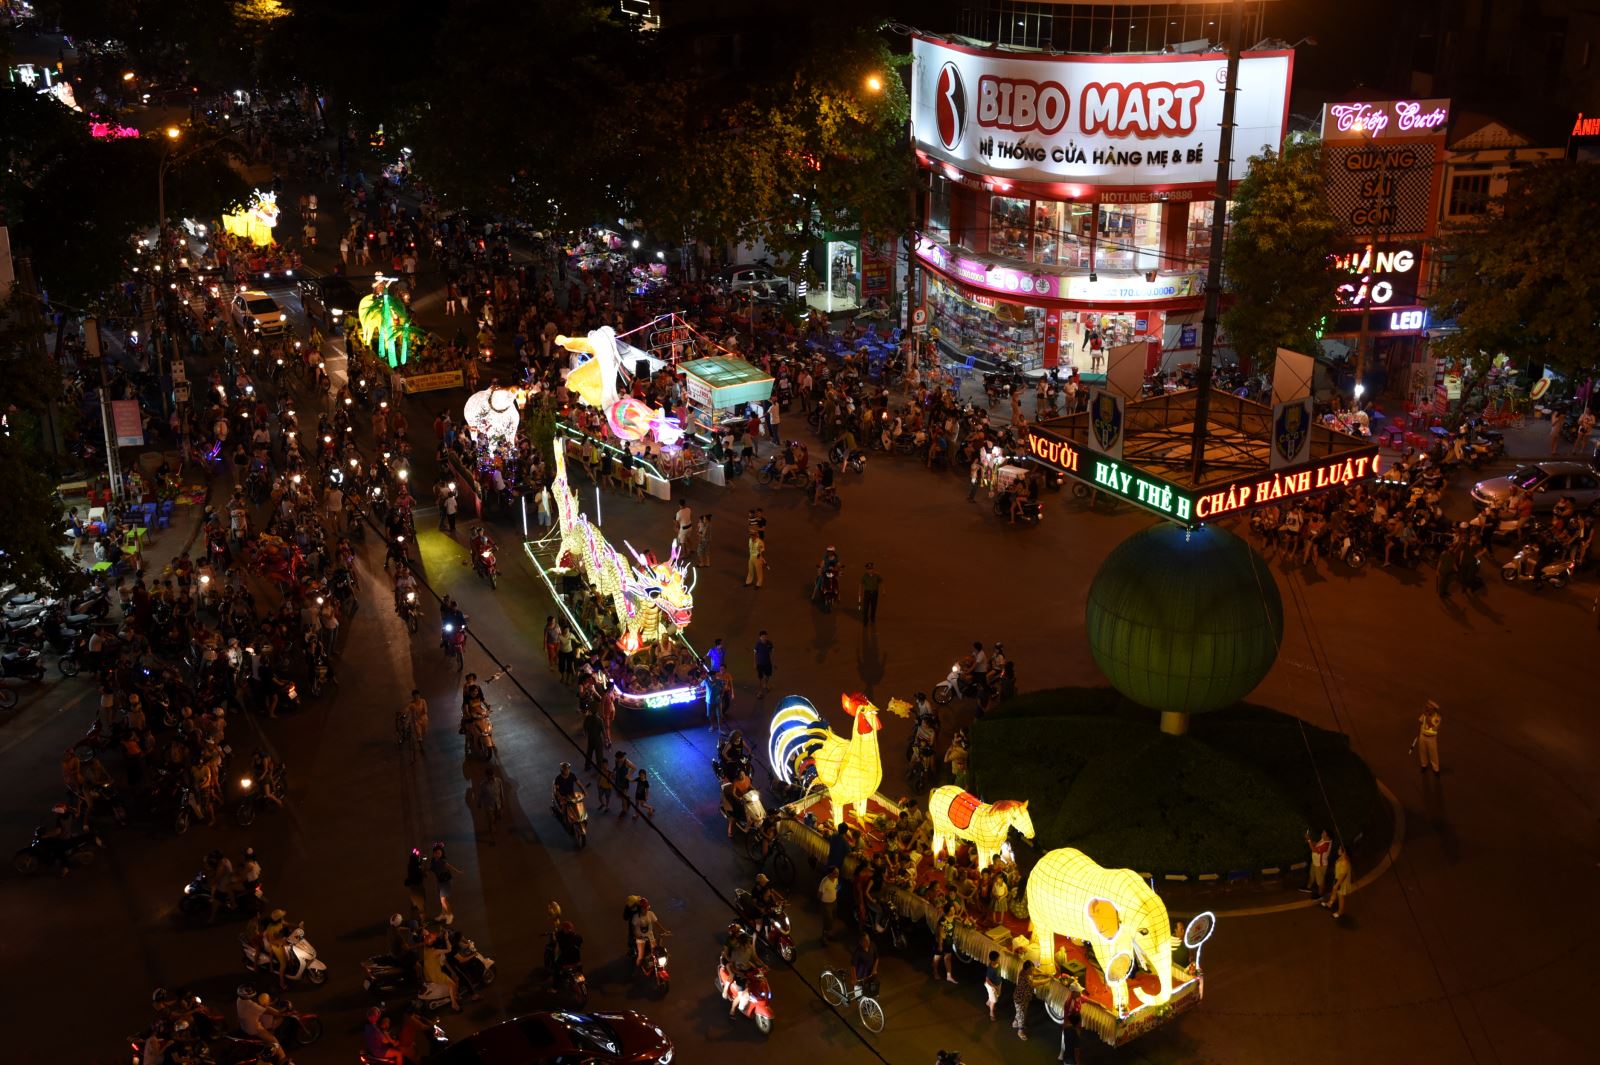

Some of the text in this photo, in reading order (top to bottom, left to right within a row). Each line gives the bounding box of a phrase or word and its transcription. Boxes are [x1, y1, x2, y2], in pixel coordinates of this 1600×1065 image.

[977, 75, 1202, 135] BIBO MART
[1331, 101, 1446, 138] Thiếp Cưới
[979, 137, 1203, 169] HỆ THỐNG CỬA HÀNG MẸ & BÉ
[1326, 244, 1414, 275] UẢNG
[1390, 310, 1423, 330] LED
[1028, 433, 1190, 519] NGƯỜI HÃY THỂ H
[1196, 484, 1250, 518] CHẤP
[1255, 473, 1312, 503] HÀNH
[1316, 457, 1368, 486] LUẬT
